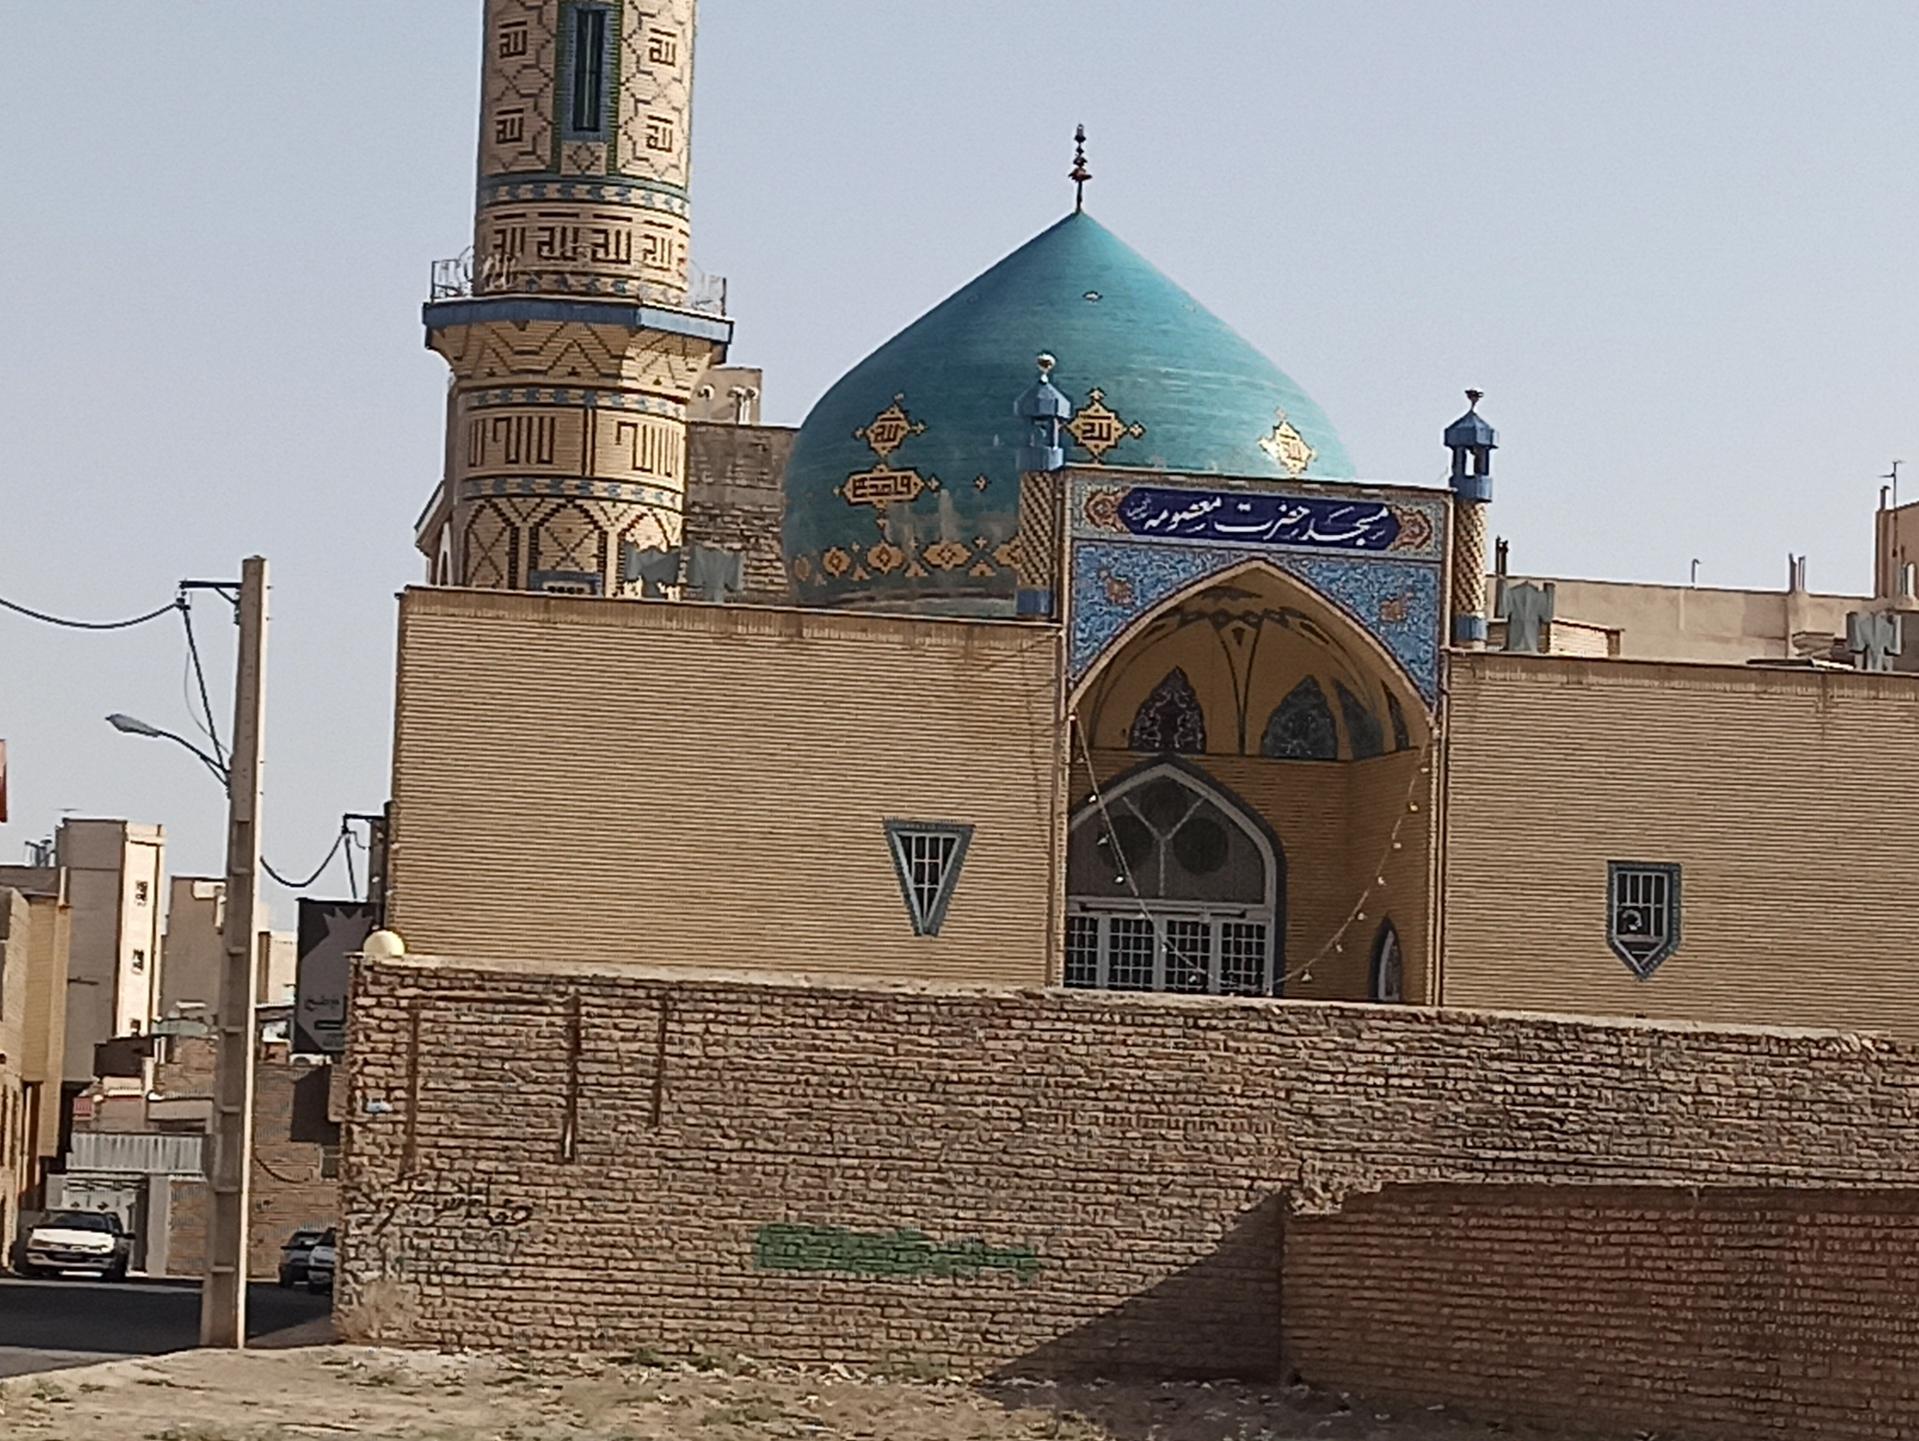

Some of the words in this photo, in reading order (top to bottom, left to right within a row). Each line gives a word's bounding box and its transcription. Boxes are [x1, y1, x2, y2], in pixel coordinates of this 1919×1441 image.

[1143, 496, 1222, 533] معصومه
[1214, 500, 1311, 541] حضرت
[1298, 504, 1391, 546] مسجد
